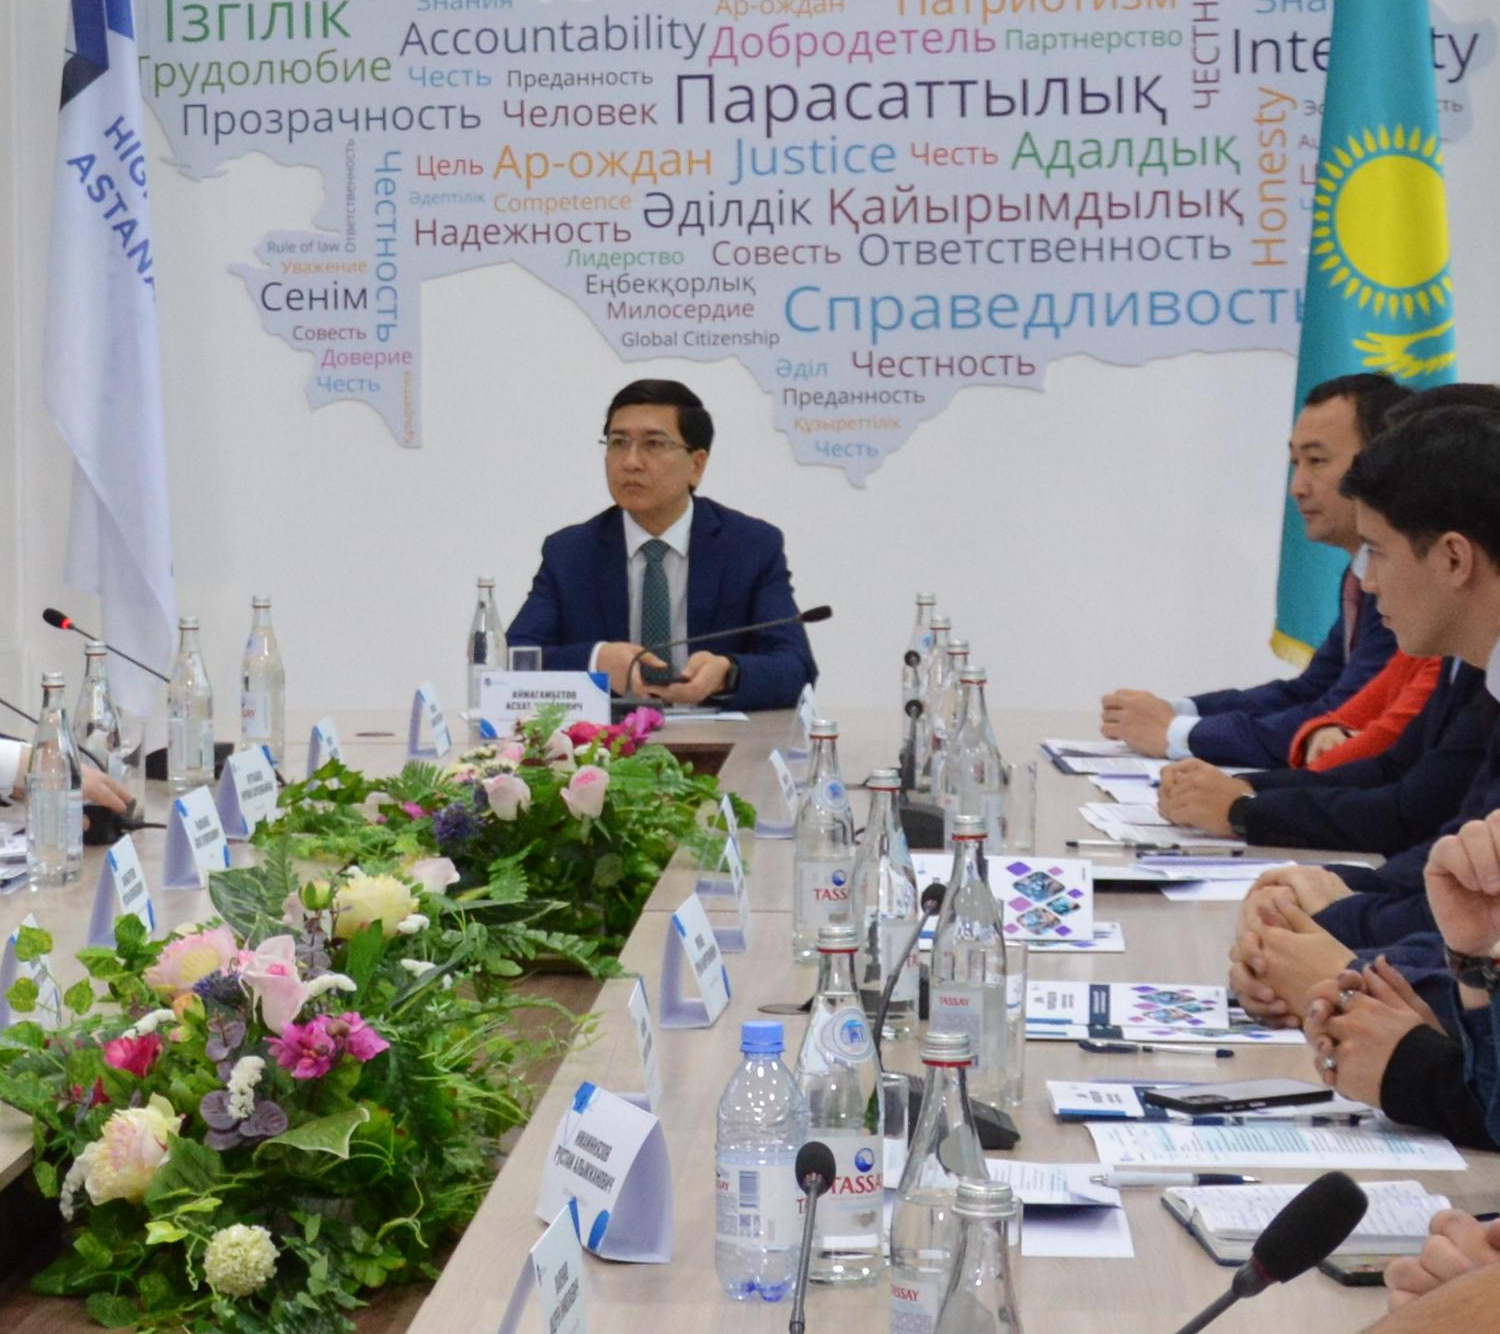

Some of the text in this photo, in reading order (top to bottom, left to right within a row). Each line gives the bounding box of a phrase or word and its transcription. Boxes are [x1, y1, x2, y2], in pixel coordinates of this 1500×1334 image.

[399, 14, 706, 60] Accountability
[708, 23, 997, 67] Добродетель
[1004, 28, 1184, 56] Партнерство
[1233, 27, 1480, 84] Intety
[408, 66, 492, 88] Честь
[507, 68, 655, 92] Преданность
[503, 99, 658, 129] Человек
[675, 73, 1169, 139] Парасаттылық
[183, 102, 482, 145] Прозрачность
[104, 115, 149, 199] HIG
[416, 154, 485, 180] Цель
[493, 144, 713, 190] Ар-ождан
[728, 137, 898, 186] Justice
[910, 139, 999, 169] Честь
[1010, 131, 1242, 176] Адалдық
[1251, 86, 1299, 267] Honesty
[493, 192, 632, 215] Competence
[643, 190, 812, 237] Әділдік
[827, 184, 1245, 234] Қайырымдылық
[66, 153, 157, 303] ASTAN
[414, 218, 632, 252] Надежность
[374, 150, 403, 343] Честность
[566, 249, 685, 270] Лидерство
[712, 240, 842, 267] Совесть
[858, 229, 1232, 268] Ответственность
[260, 280, 369, 312] Сенім
[607, 300, 756, 324] Милосердие
[292, 325, 368, 341] Совесть
[621, 328, 781, 349] Global Citizenship
[321, 347, 413, 369] Доверие
[852, 349, 1037, 380] Честность
[315, 375, 382, 393] Честь
[782, 387, 927, 409] Преданность
[814, 440, 881, 458] Честь
[813, 888, 848, 901] TASS
[828, 1173, 884, 1196] TASSA
